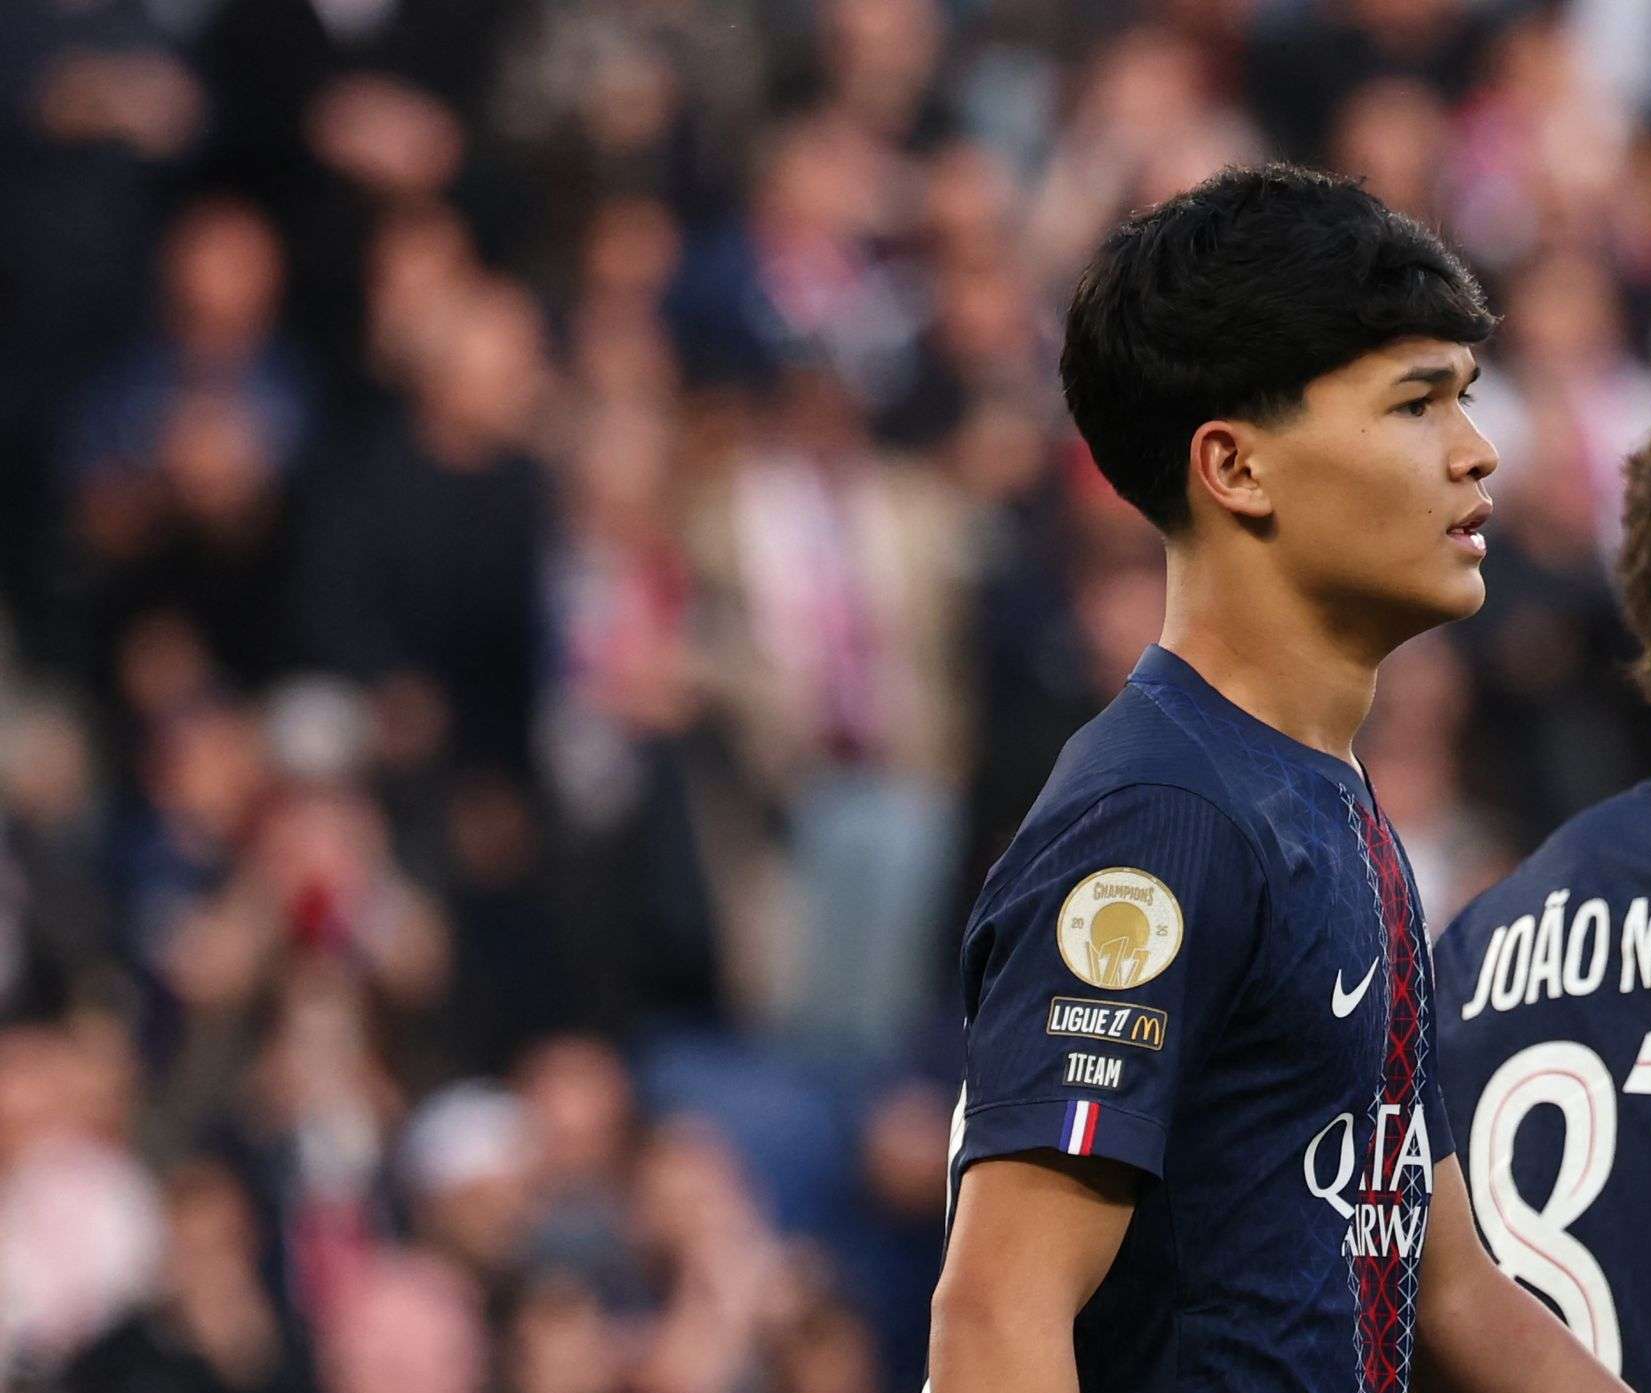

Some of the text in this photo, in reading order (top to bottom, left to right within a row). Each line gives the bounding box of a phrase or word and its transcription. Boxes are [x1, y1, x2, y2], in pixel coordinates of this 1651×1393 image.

[1093, 881, 1154, 906] CHAMPIONS
[1462, 889, 1611, 1020] JOÃO
[1051, 1005, 1110, 1035] LIGUE
